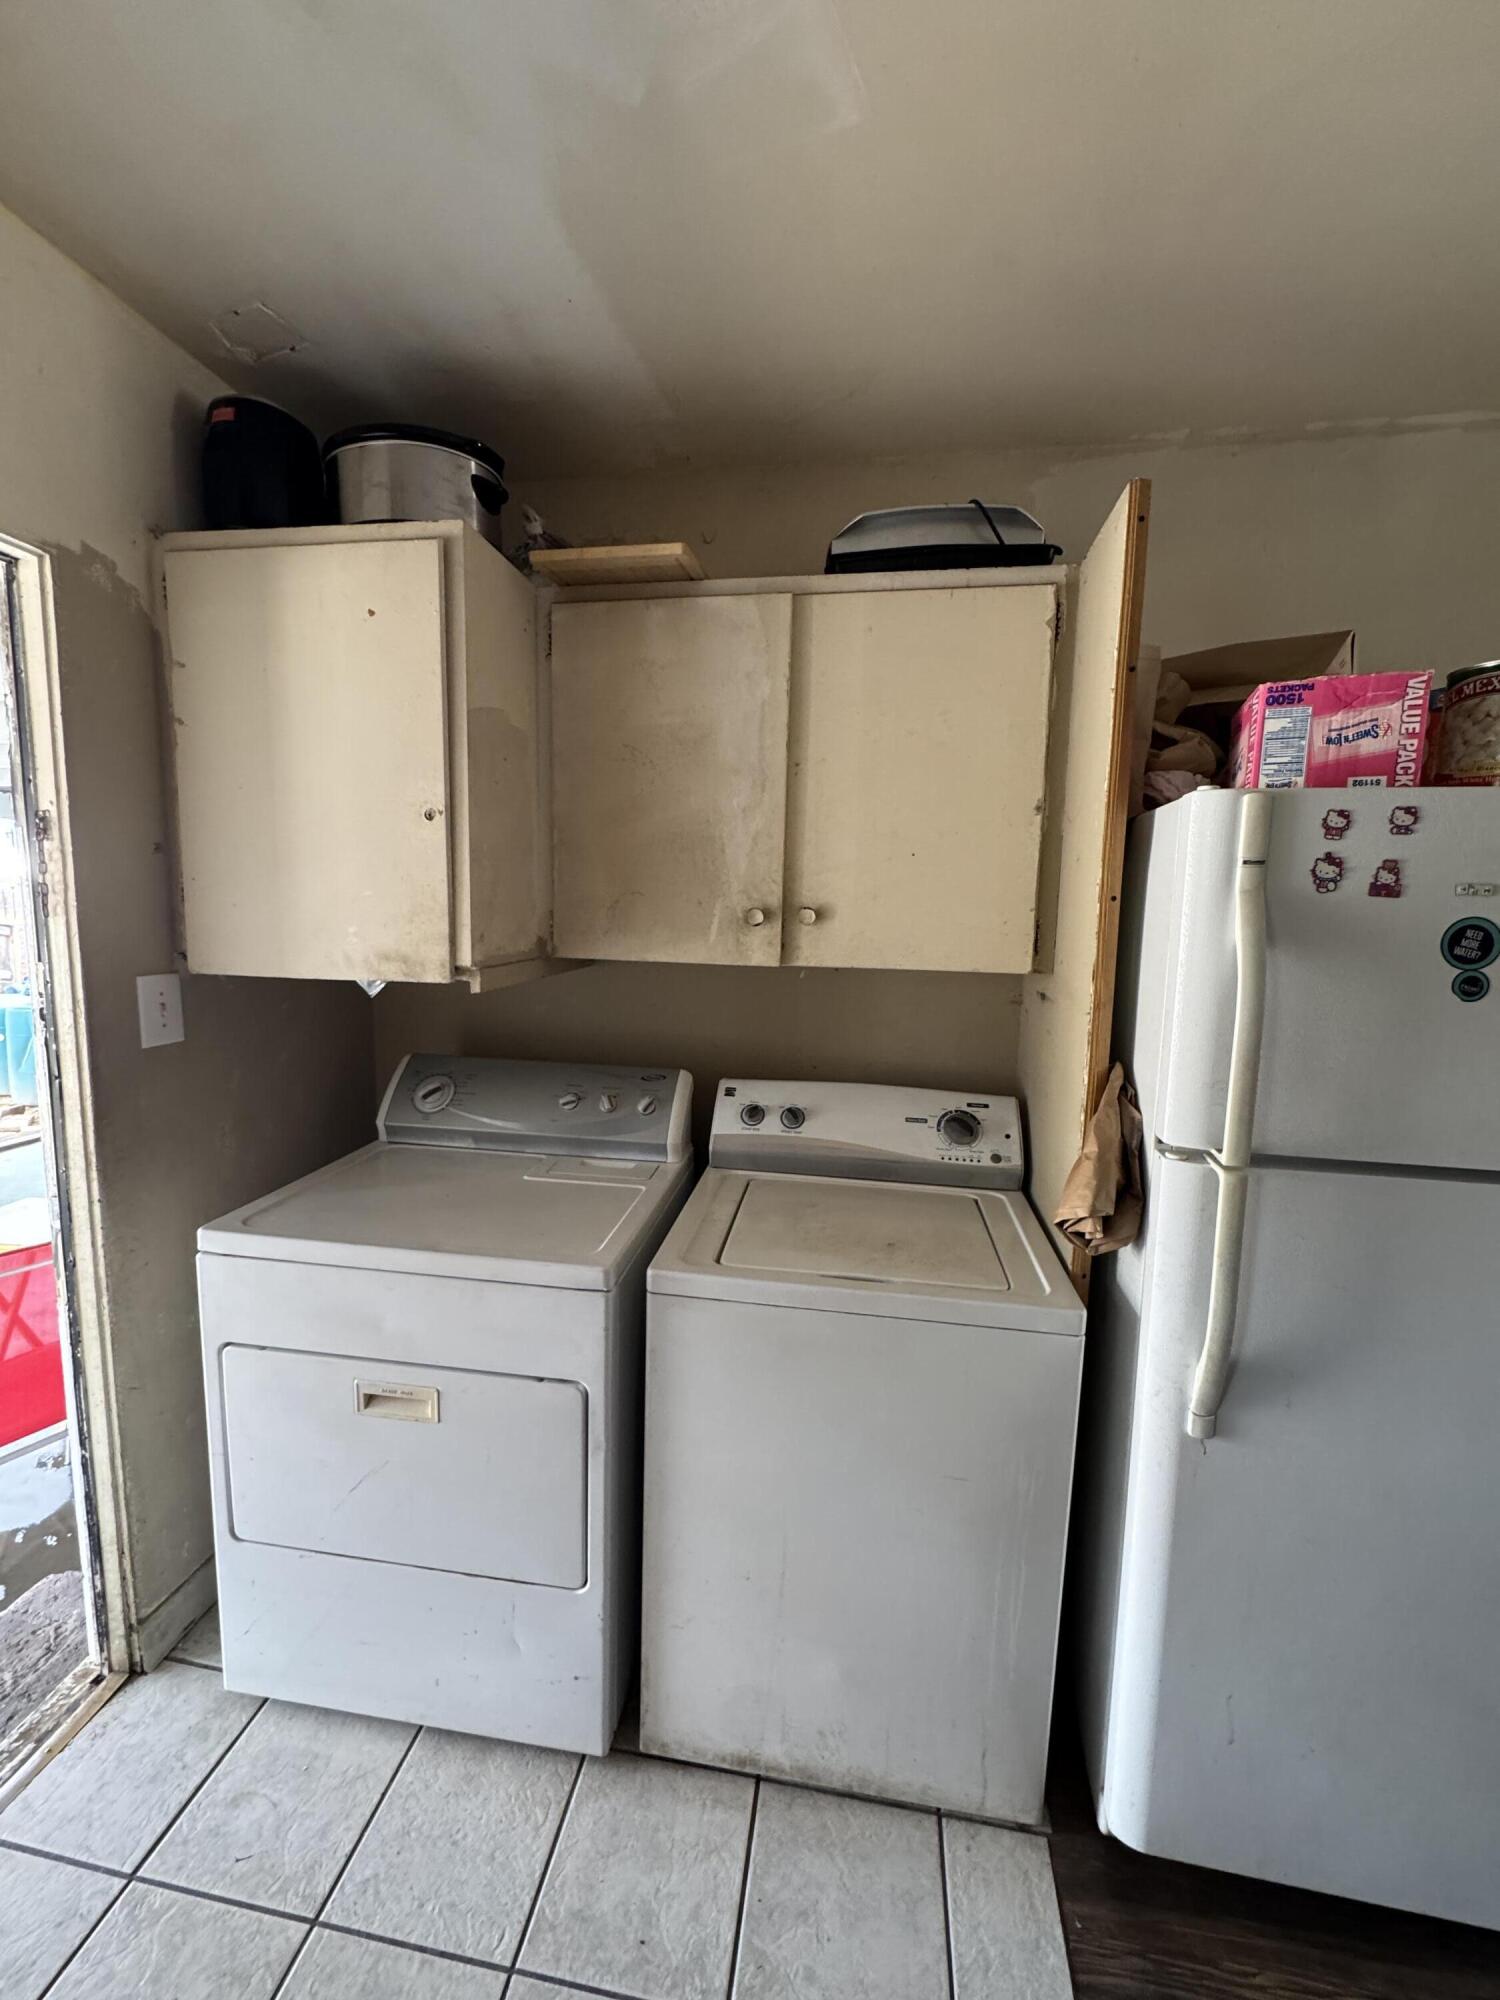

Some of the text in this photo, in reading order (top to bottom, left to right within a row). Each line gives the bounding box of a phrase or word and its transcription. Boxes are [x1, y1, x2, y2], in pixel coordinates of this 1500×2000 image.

[1267, 683, 1315, 694] PACKETS
[1266, 693, 1305, 706] 1500
[1249, 691, 1260, 744] VALUE
[1395, 675, 1428, 787] VALUE PACK
[1352, 779, 1381, 787] 51192
[1465, 929, 1484, 940] NEED
[1460, 938, 1480, 949] MORE
[1453, 946, 1482, 960] WATER?
